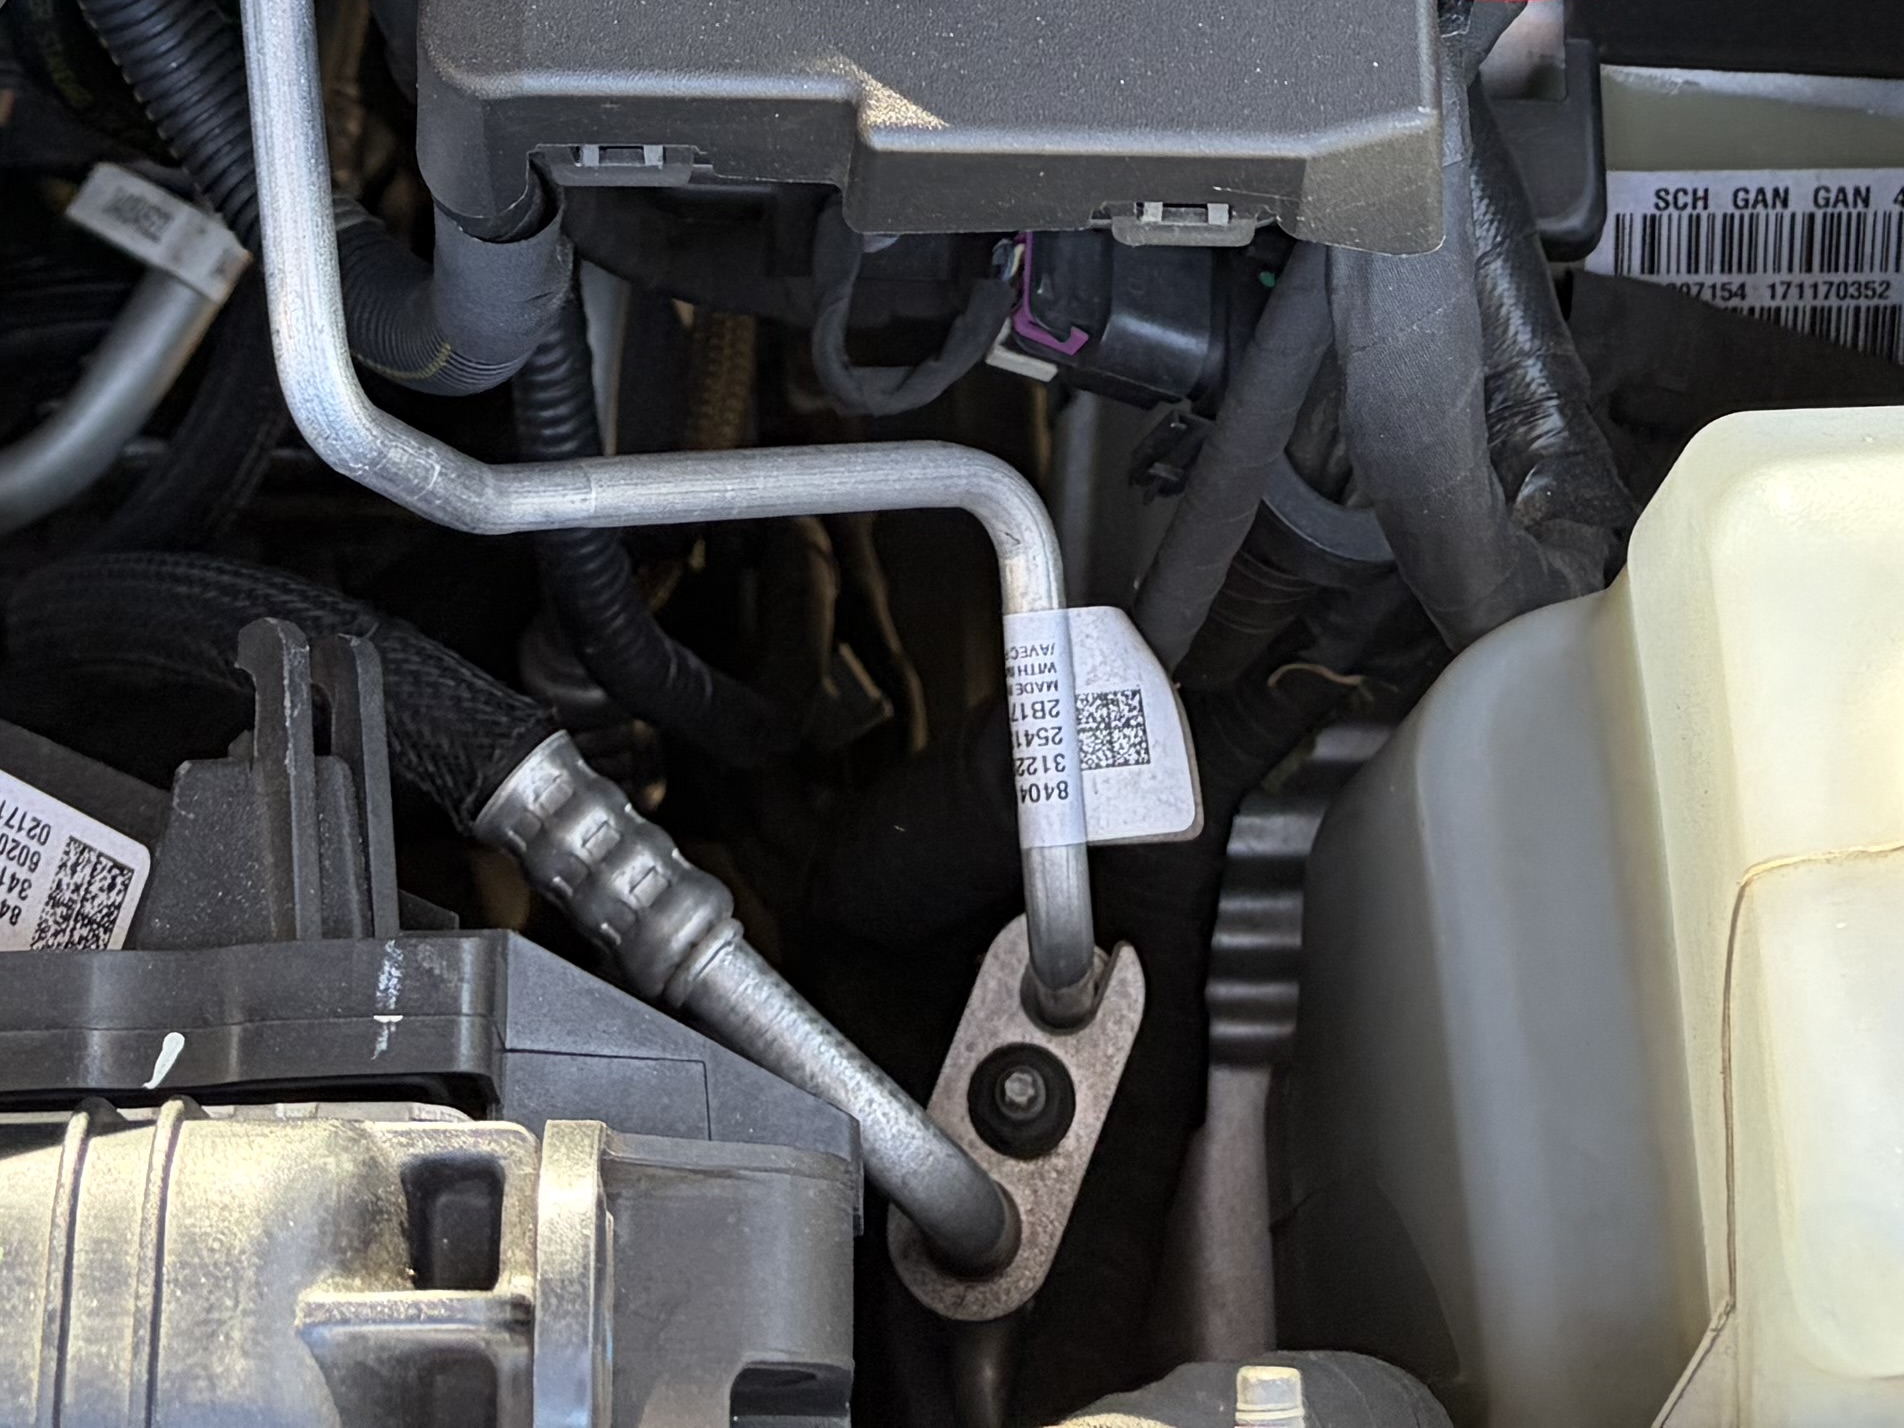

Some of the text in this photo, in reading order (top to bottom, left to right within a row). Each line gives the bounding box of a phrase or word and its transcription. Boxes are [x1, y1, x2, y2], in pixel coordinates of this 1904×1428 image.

[1653, 187, 1710, 212] SCH
[1732, 186, 1790, 211] GAN
[1812, 185, 1871, 209] GAN
[1767, 279, 1892, 302] 171170352
[1017, 661, 1058, 677] WITH
[1015, 679, 1059, 696] MADE
